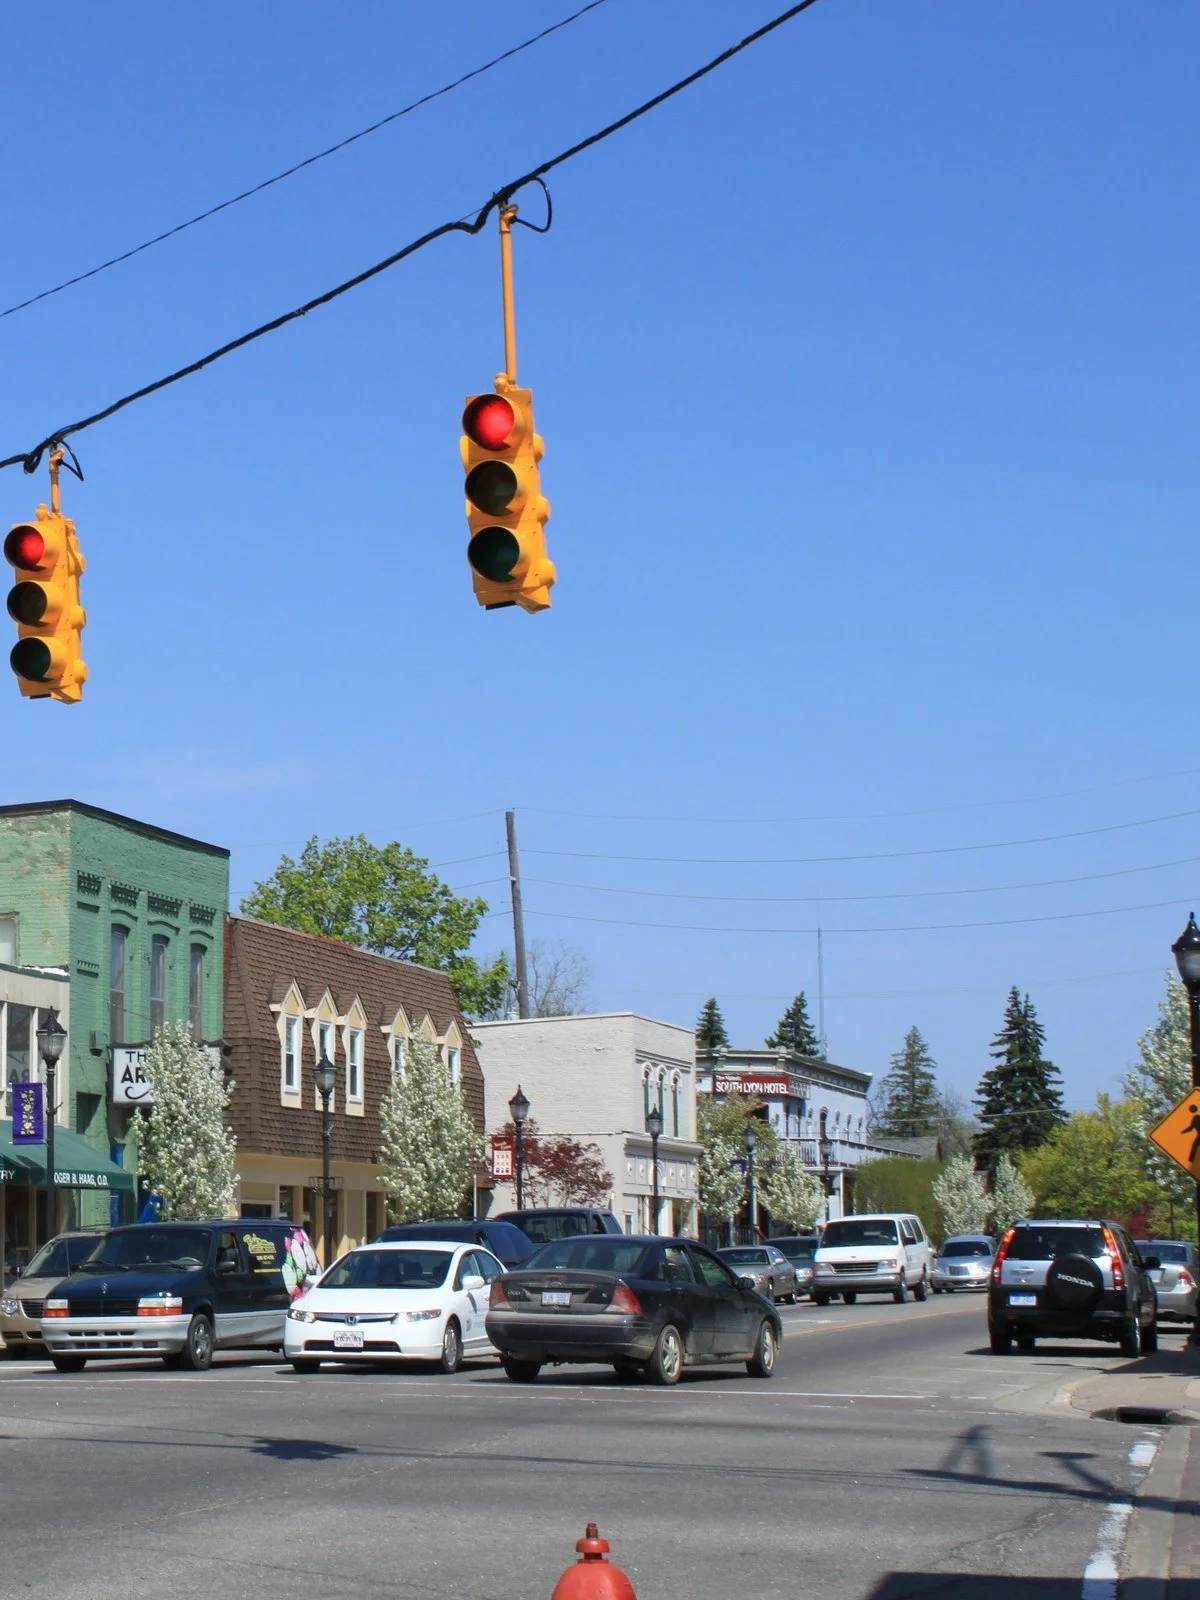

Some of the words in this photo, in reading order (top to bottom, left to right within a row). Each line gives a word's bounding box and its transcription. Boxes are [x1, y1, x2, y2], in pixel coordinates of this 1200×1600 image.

[715, 1081, 742, 1093] SOUTH
[743, 1082, 763, 1094] LYON
[764, 1083, 790, 1094] HOTEL
[53, 1171, 71, 1184] OGER
[71, 1173, 78, 1184] B.
[78, 1174, 97, 1187] HAAG,
[96, 1176, 109, 1187] O.D.
[1056, 1272, 1095, 1288] HONDA
